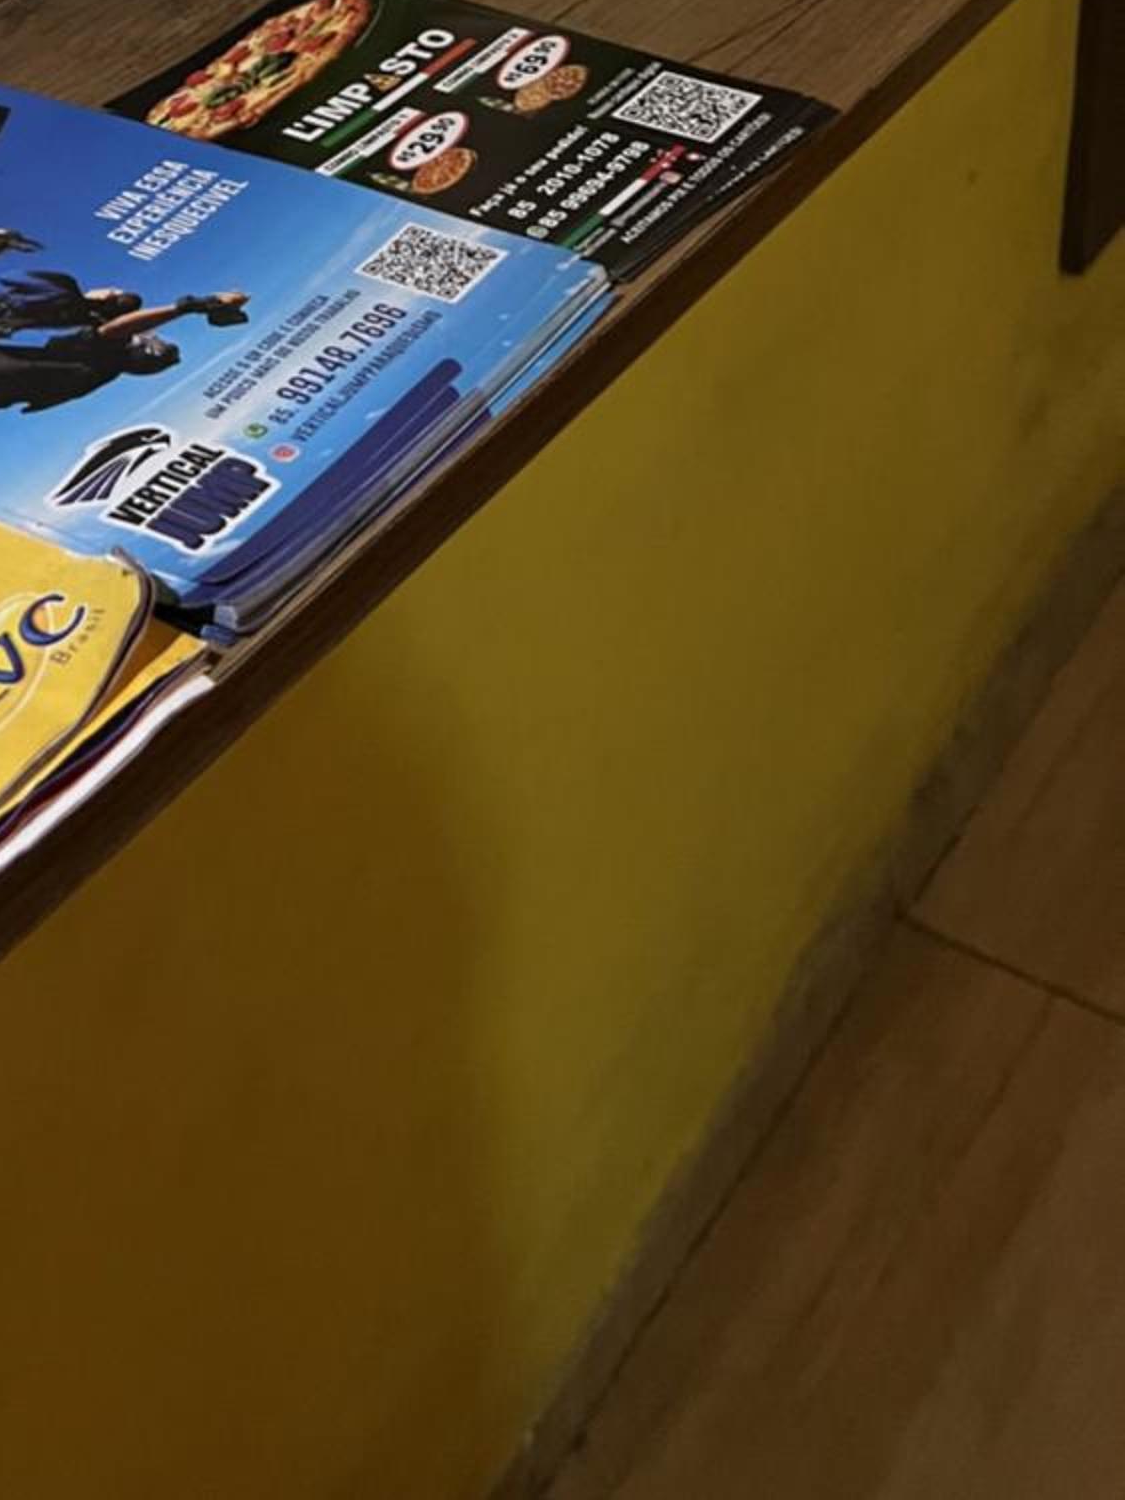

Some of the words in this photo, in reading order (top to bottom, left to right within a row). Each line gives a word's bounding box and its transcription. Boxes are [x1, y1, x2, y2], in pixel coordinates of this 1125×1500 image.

[94, 189, 149, 220] VIVA
[134, 160, 189, 191] ESSA
[107, 169, 220, 242] EXPERIÊNCIA
[128, 178, 250, 260] INESQUECÍVEL
[507, 200, 537, 220] 85
[538, 209, 568, 228] 85
[276, 303, 407, 405] 99148.7696
[108, 442, 225, 527] VERTICAL
[147, 456, 271, 549] JUMP
